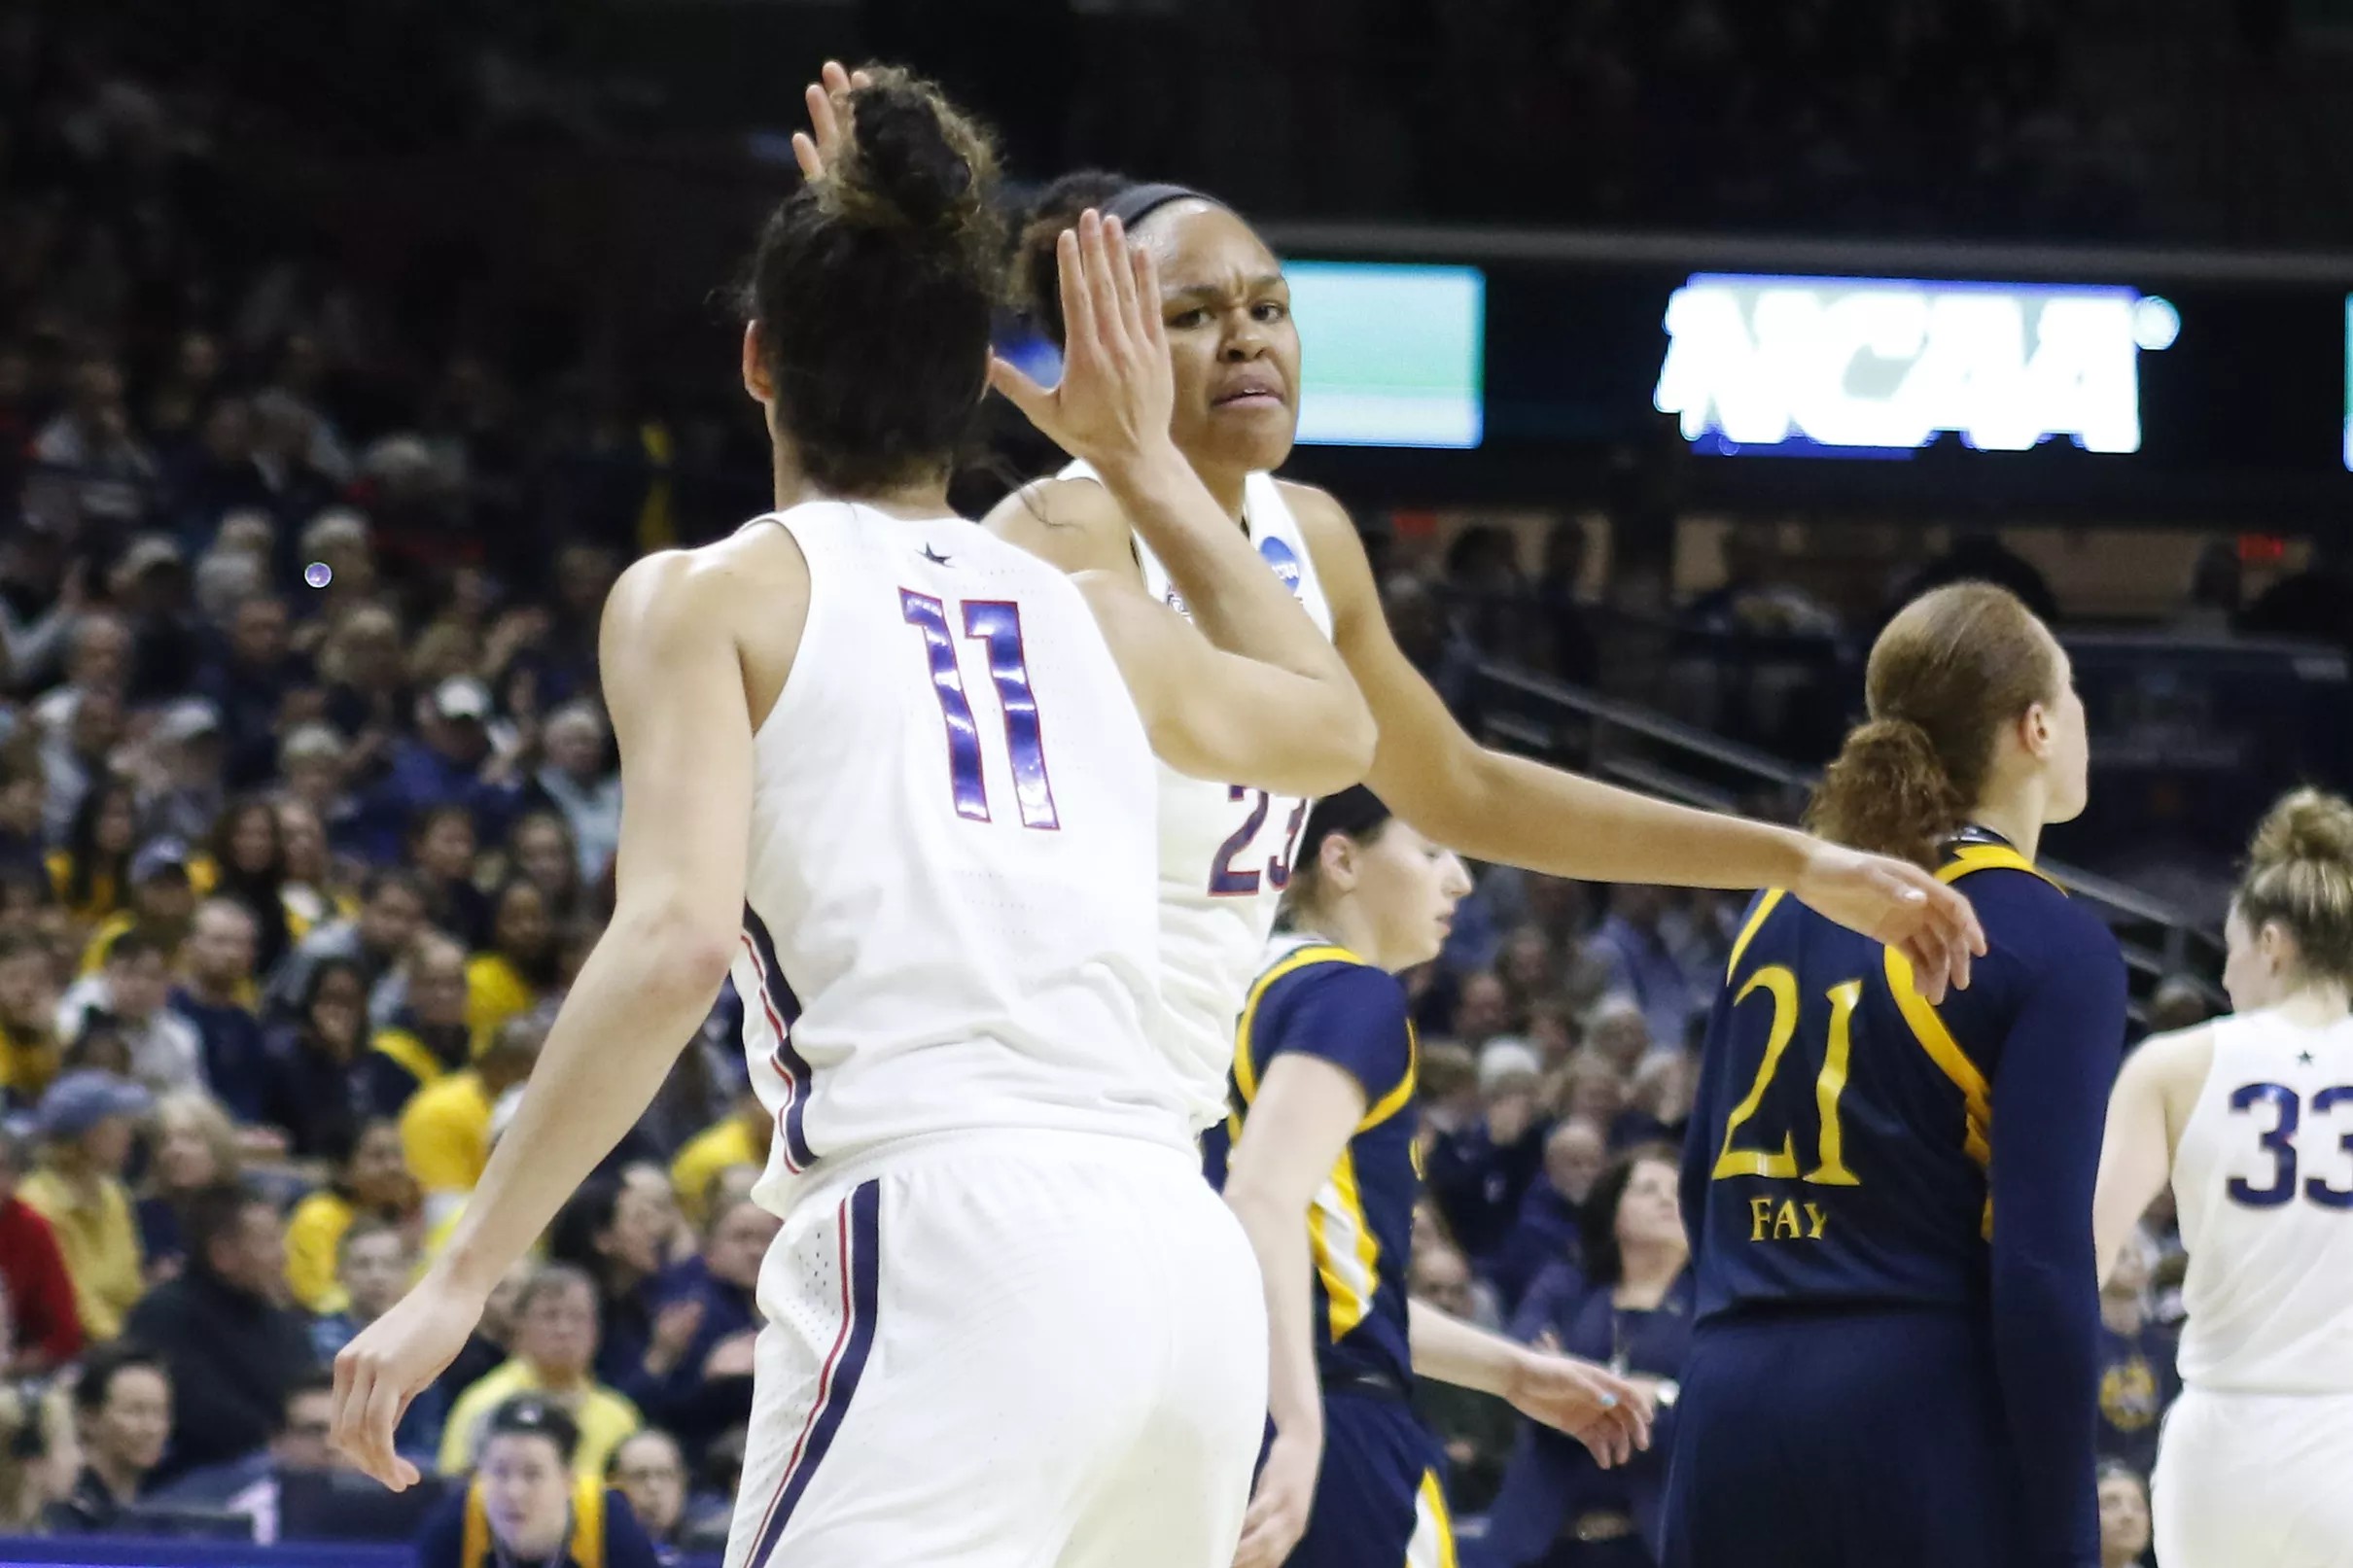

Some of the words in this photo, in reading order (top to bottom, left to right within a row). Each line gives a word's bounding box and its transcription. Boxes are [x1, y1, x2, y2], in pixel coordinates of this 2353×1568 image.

[1654, 286, 2141, 454] NCAA
[898, 586, 1060, 830] 11
[1207, 784, 1307, 897] 23
[1711, 965, 1862, 1186] 21
[2226, 1081, 2353, 1209] 33
[1749, 1198, 1828, 1241] FAY
